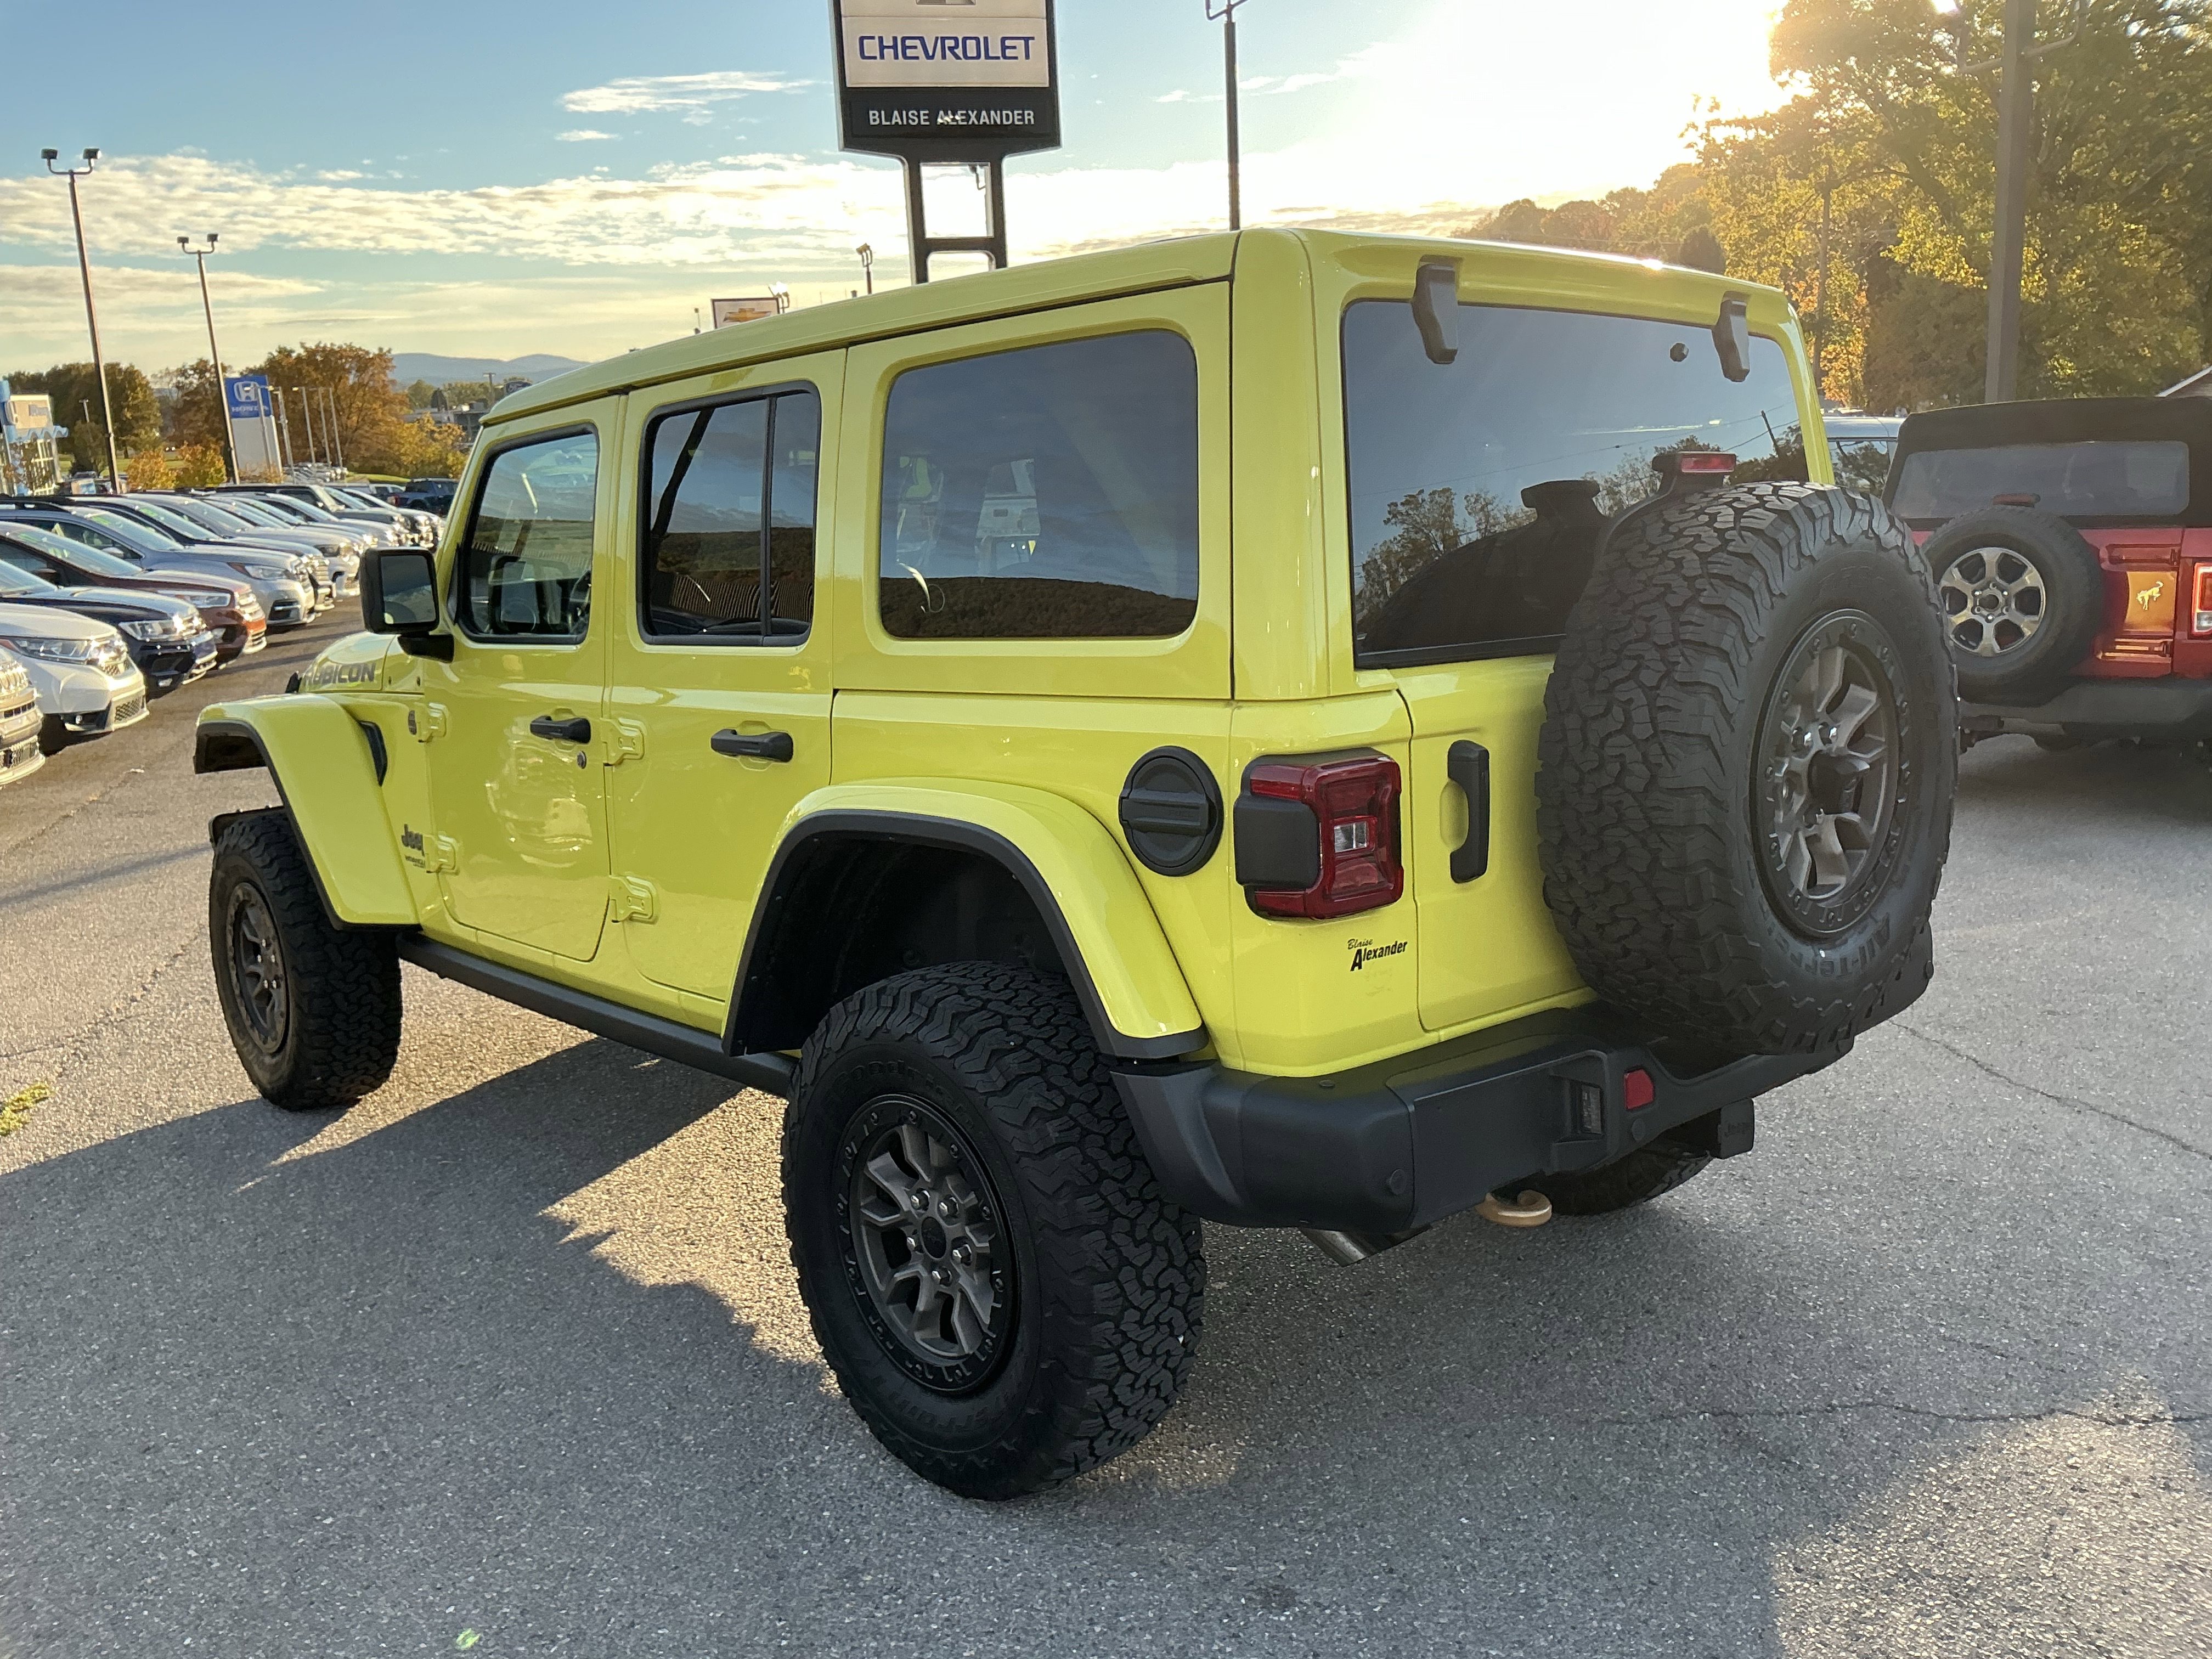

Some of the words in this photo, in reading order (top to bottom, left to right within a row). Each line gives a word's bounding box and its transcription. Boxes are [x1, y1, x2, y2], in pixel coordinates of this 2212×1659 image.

[858, 35, 1035, 60] CHEVROLET
[868, 110, 930, 126] BLAISE
[936, 110, 1035, 125] ALEXANDER
[1347, 938, 1373, 950] Blaise
[1350, 940, 1408, 972] Alexander
